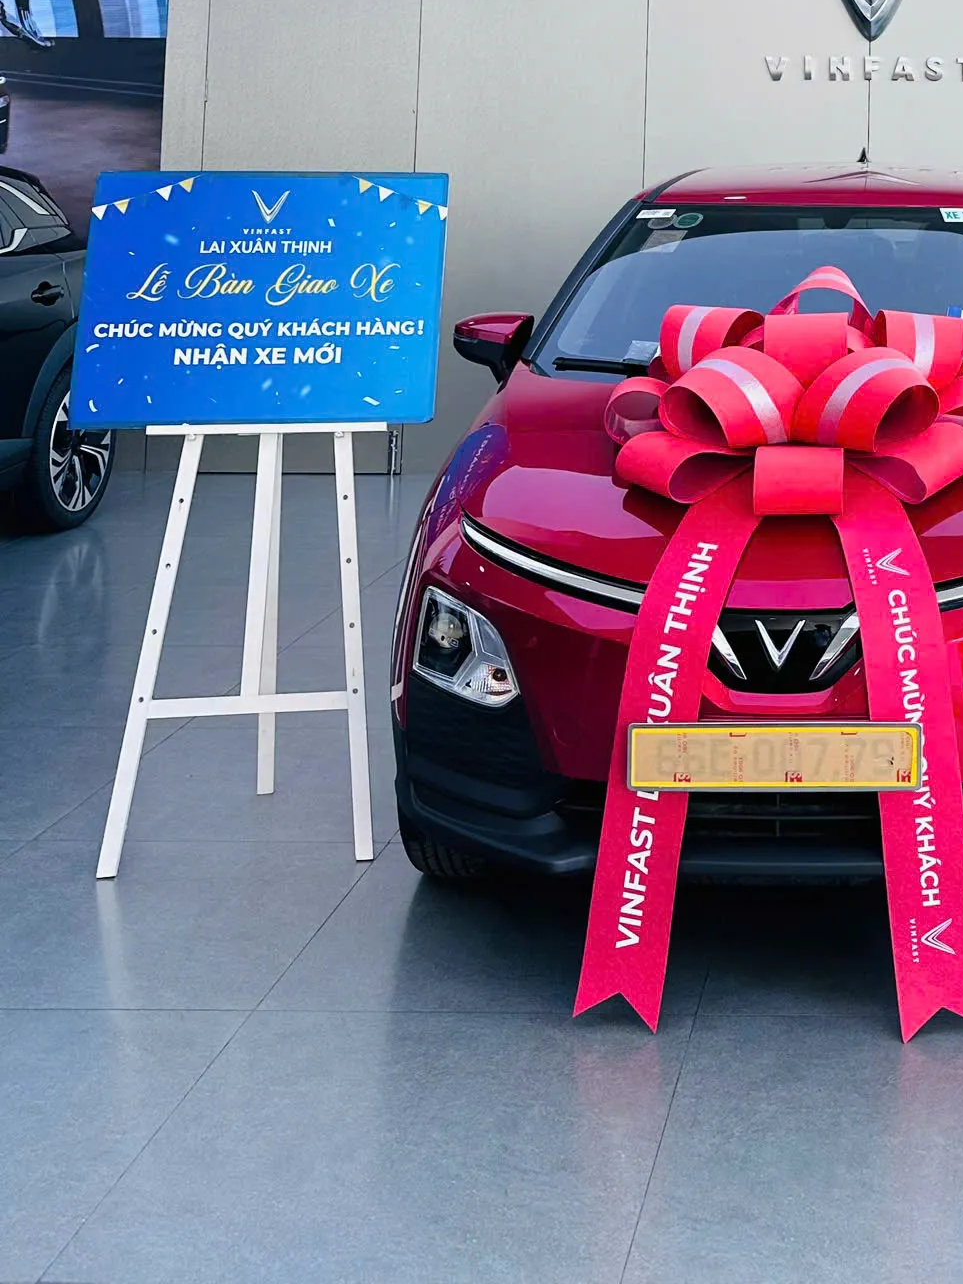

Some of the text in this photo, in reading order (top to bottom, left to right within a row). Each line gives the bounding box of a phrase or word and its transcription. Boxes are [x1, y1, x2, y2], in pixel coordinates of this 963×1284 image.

[944, 211, 959, 220] XE
[199, 238, 332, 257] LAI XUÂN THỊNH
[126, 263, 401, 306] Lễ Bàn Giao Xe
[93, 319, 154, 338] CHÚC
[158, 318, 222, 337] MỪNG
[227, 318, 271, 340] QUÝ
[277, 317, 350, 336] KHÁCH
[174, 343, 341, 370] NHẬN XE MỚI
[887, 589, 916, 664] CHÚC
[899, 669, 926, 746] MỪN
[616, 807, 656, 949] VINFAST
[664, 542, 719, 634] THỊNH
[915, 816, 941, 907] KHÁCH
[909, 918, 920, 964] VINFAST
